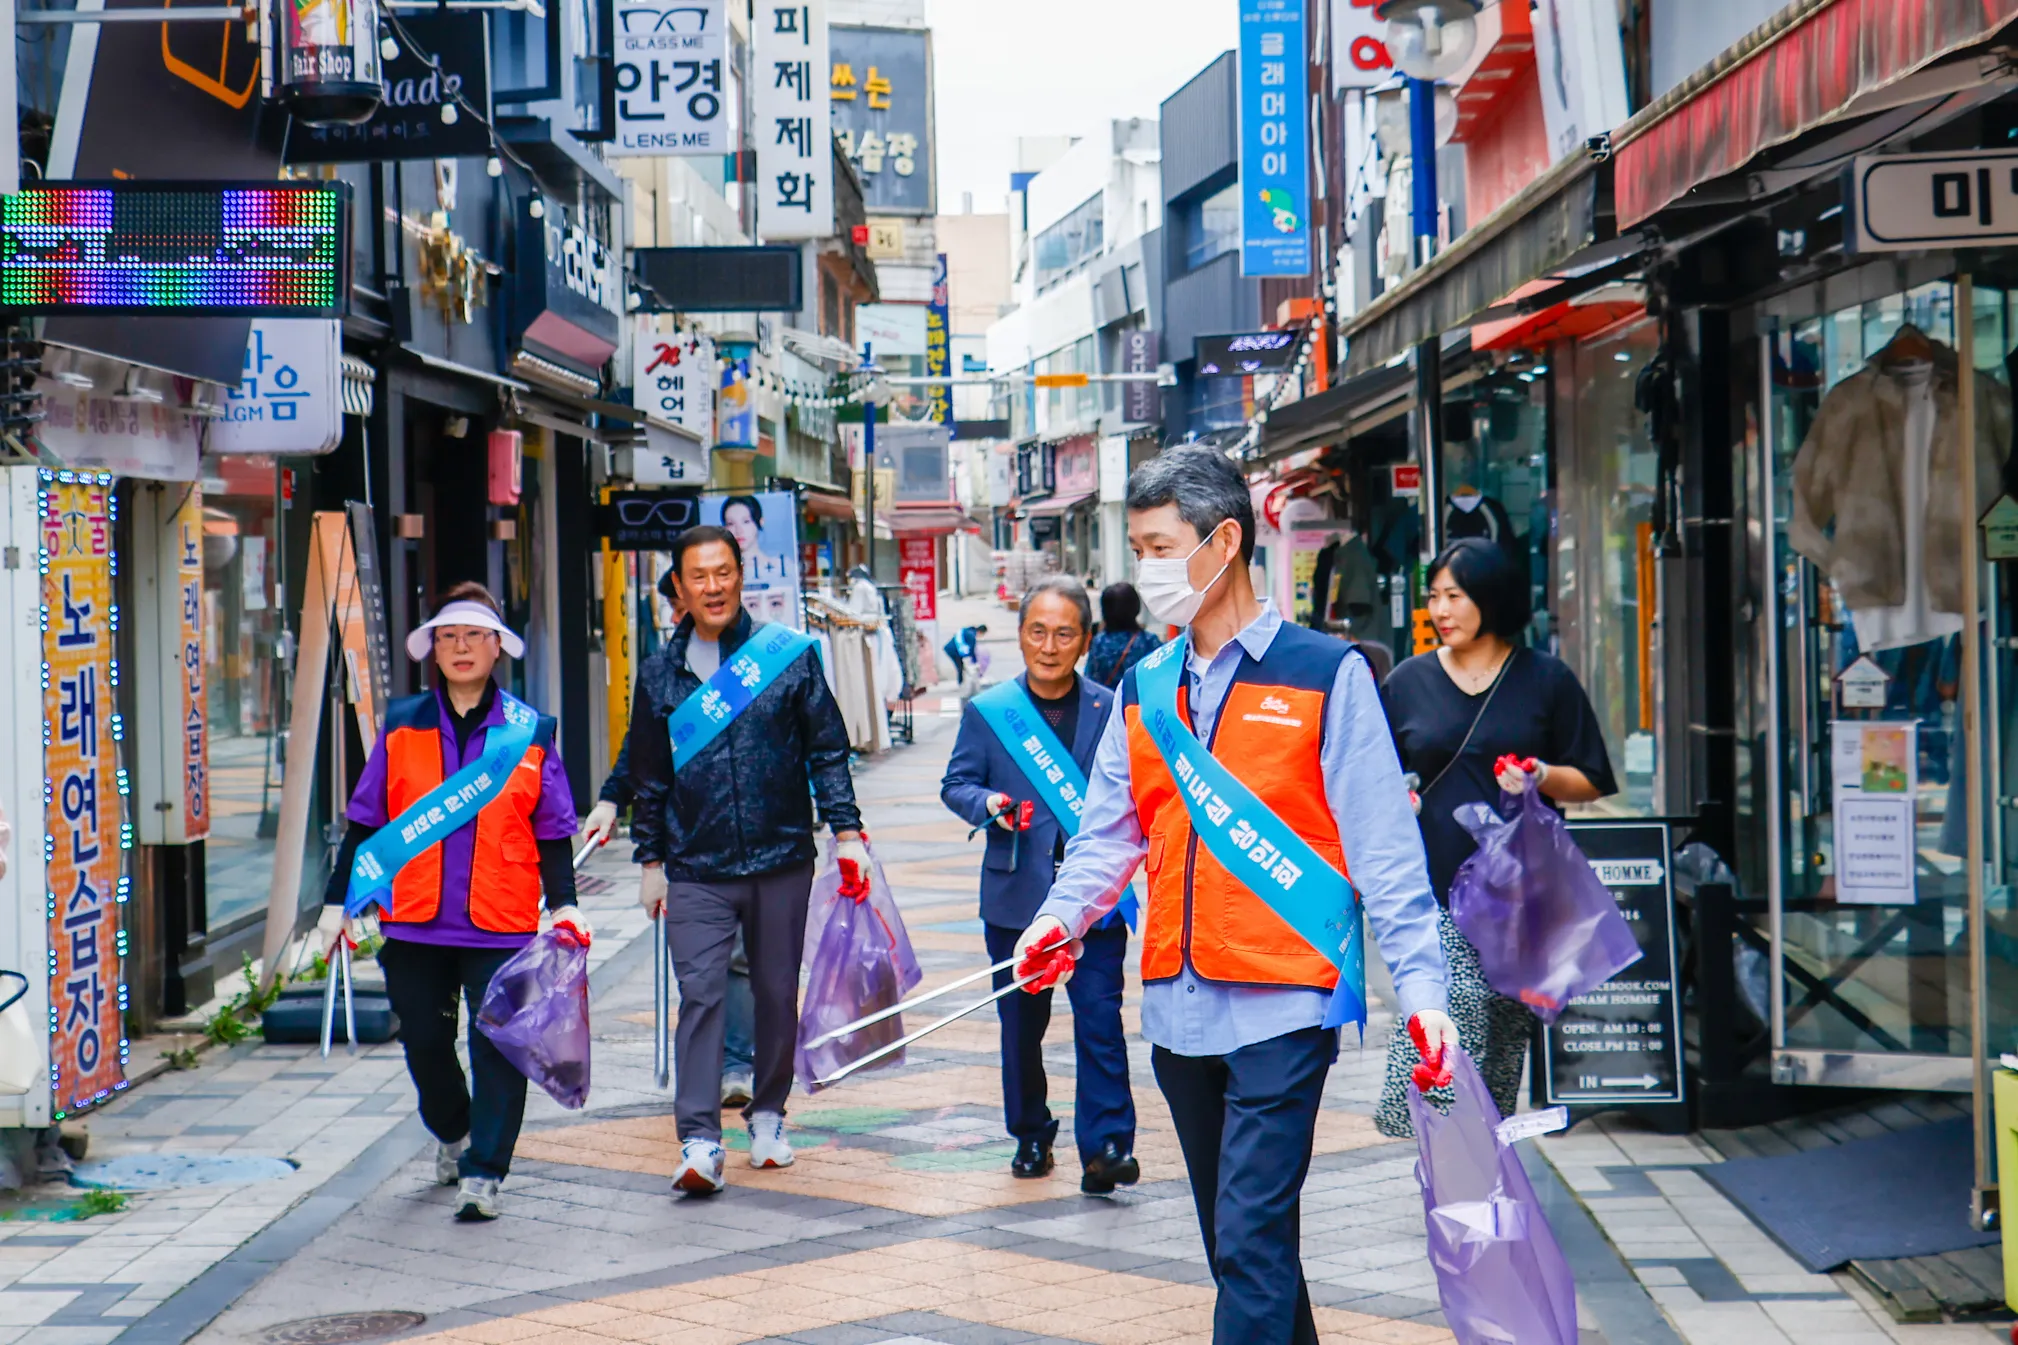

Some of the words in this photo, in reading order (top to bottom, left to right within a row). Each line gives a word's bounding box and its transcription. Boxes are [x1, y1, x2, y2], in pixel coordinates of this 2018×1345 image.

[625, 37, 678, 50] GLASS
[682, 36, 704, 49] ME
[319, 50, 351, 81] Shop
[830, 63, 893, 110] 쓰는
[614, 58, 721, 121] 안경
[624, 133, 677, 148] LENS
[683, 132, 710, 147] ME
[1932, 167, 2018, 227] 미
[183, 522, 206, 818] 노래연습장
[443, 772, 493, 815] 원도심
[57, 572, 106, 1074] 노래연습장
[400, 806, 446, 845] 상인회
[1174, 751, 1234, 828] 원도심
[1228, 818, 1304, 891] 상인회
[1602, 865, 1653, 881] HOMME
[1579, 1075, 1598, 1090] IN
